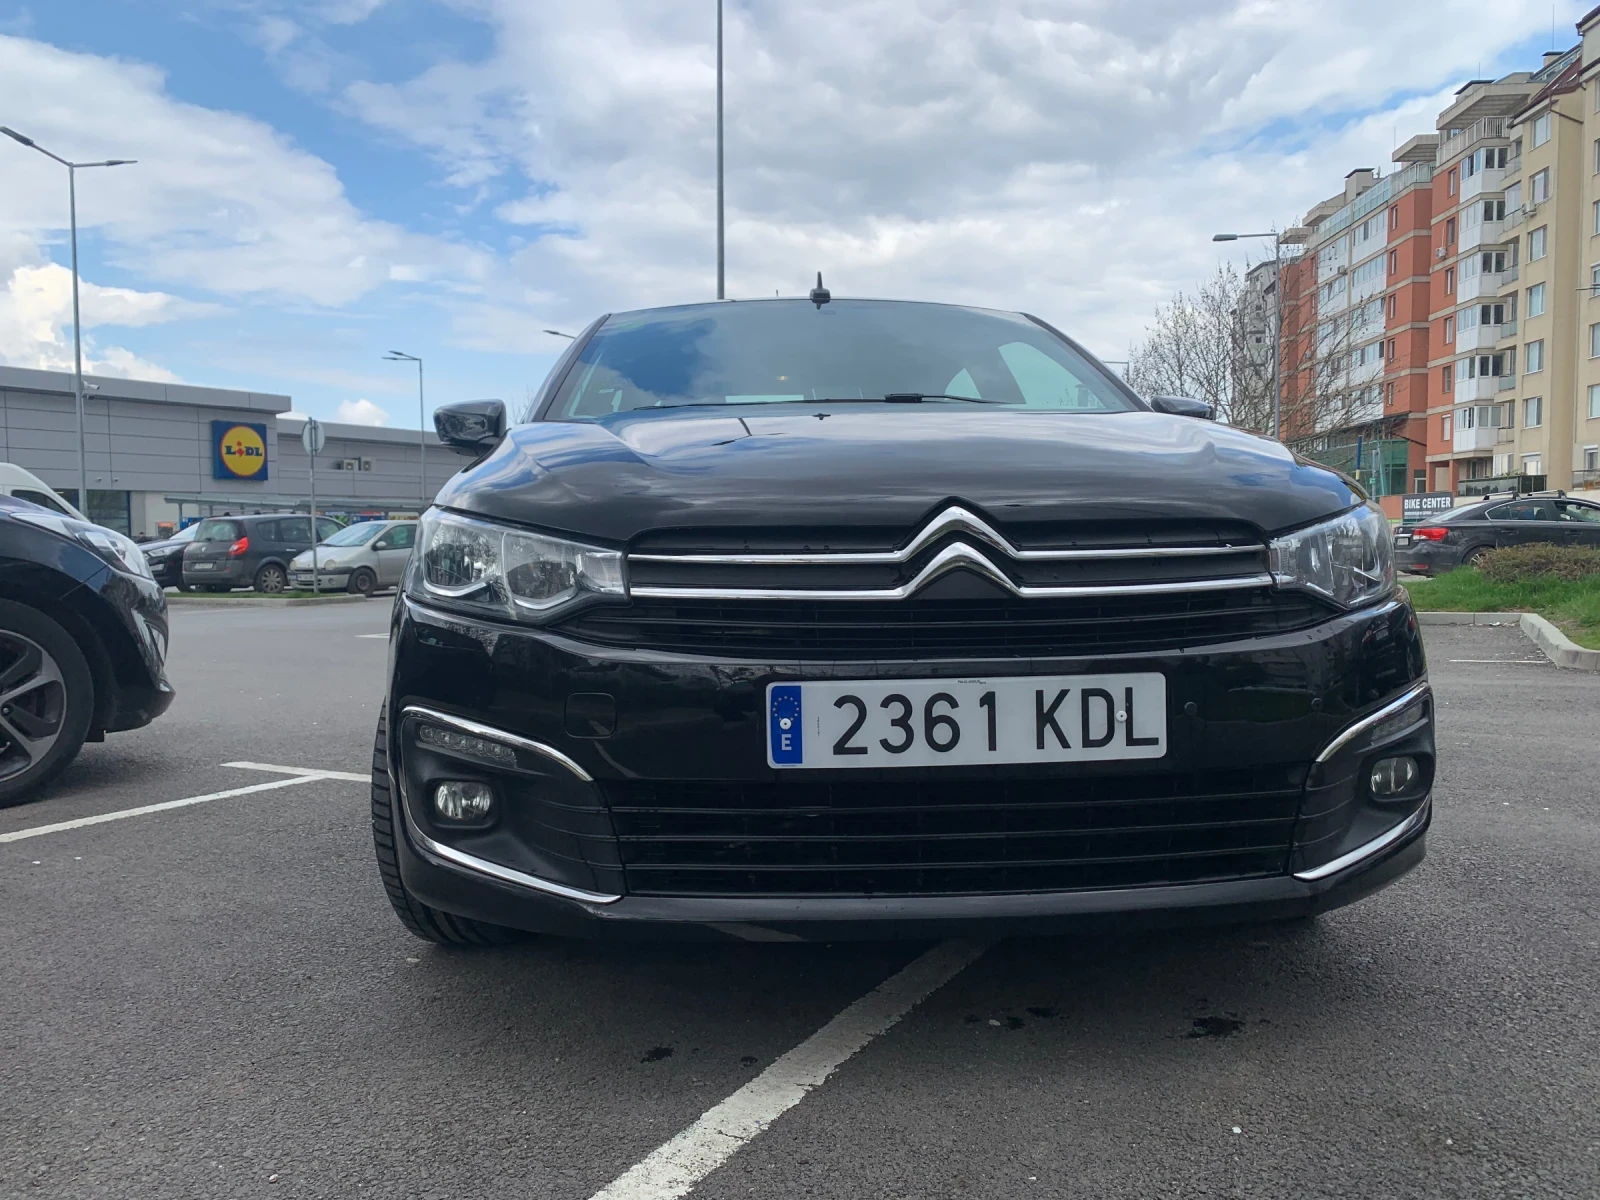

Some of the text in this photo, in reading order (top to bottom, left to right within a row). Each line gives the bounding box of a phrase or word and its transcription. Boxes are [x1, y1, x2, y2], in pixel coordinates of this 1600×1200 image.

[1404, 497, 1451, 509] BIKE CENTER
[833, 687, 1159, 755] 2361 KDL
[782, 734, 792, 750] E
